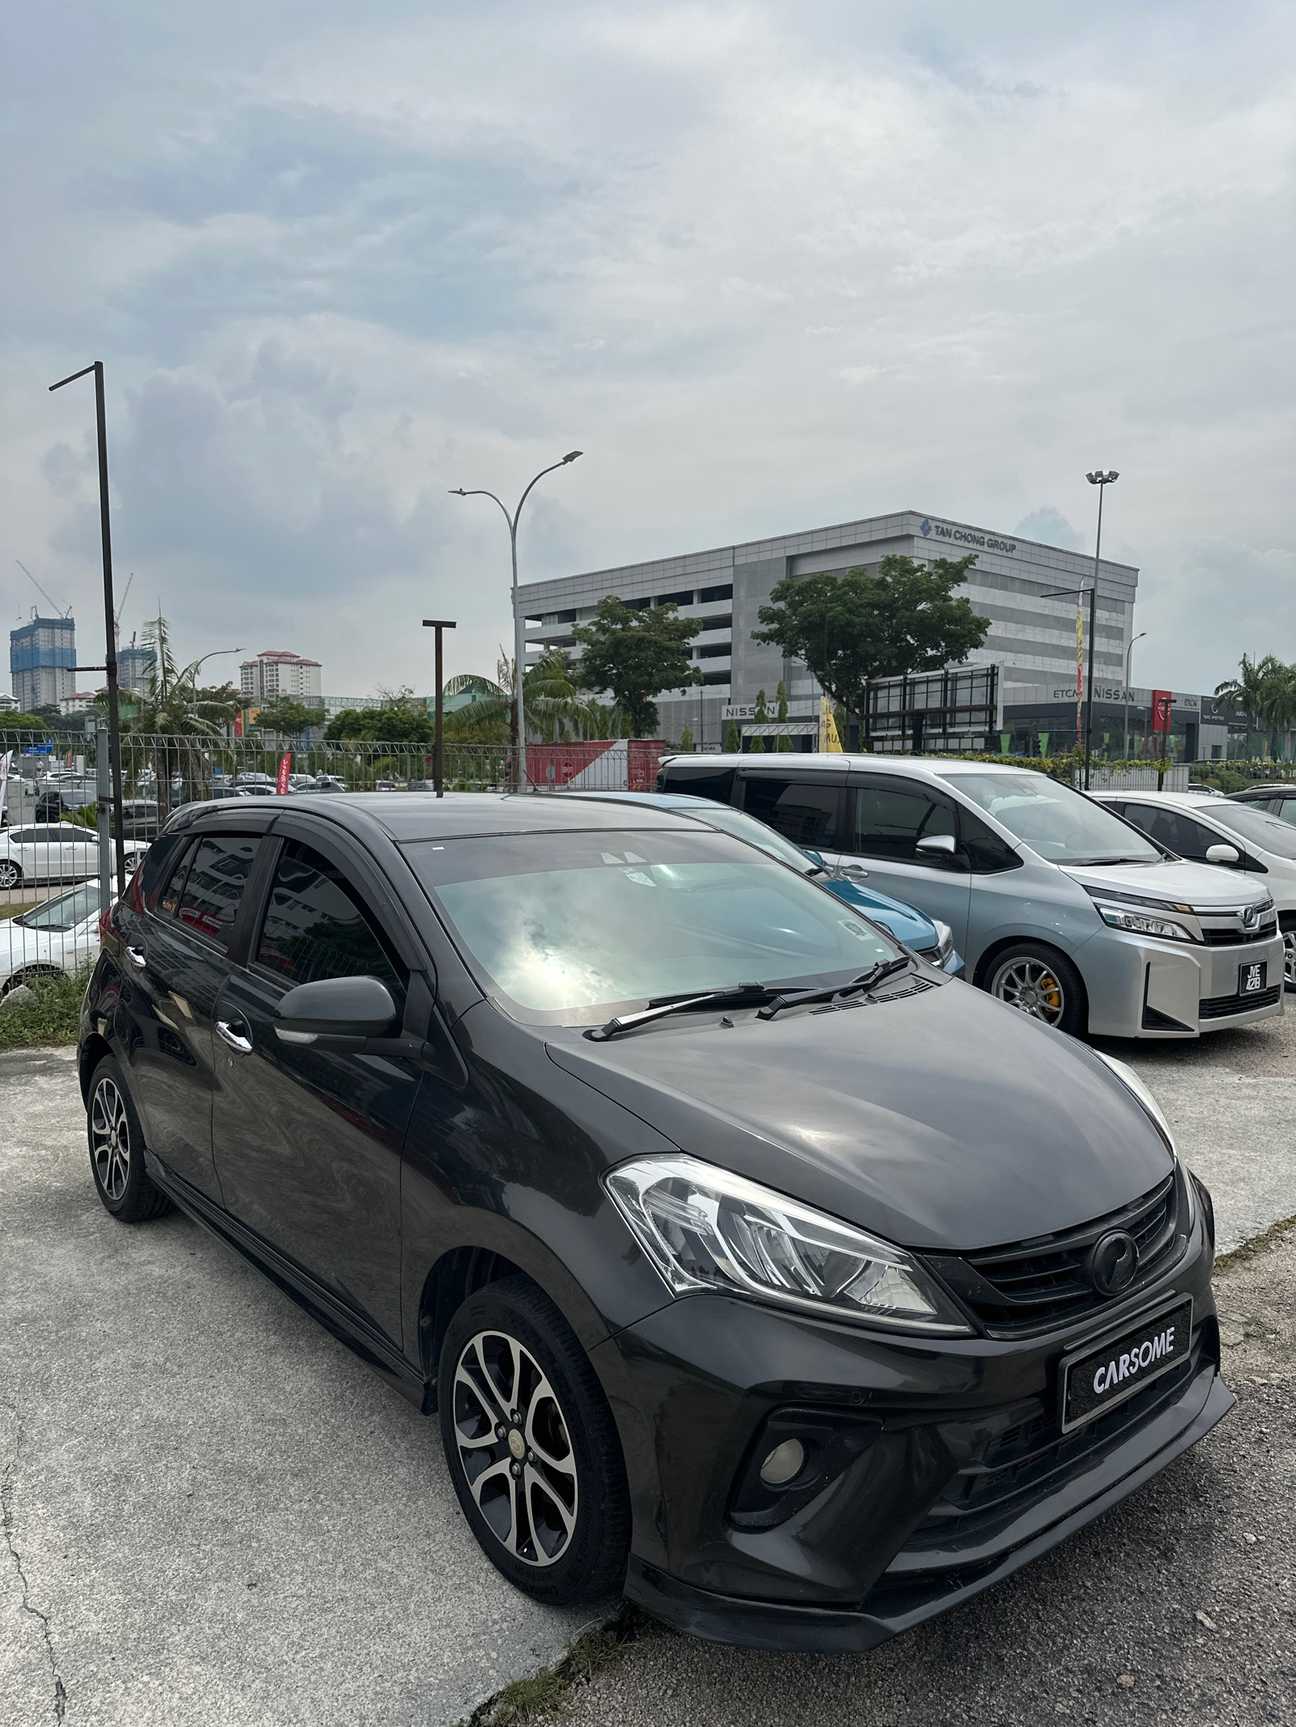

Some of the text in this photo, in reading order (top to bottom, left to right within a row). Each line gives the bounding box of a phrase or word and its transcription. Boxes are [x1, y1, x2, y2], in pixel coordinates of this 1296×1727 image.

[934, 525, 1017, 554] TAN CHONG GROUP
[1094, 687, 1135, 702] NISSAN
[726, 706, 775, 717] NISSN
[1093, 1326, 1175, 1394] CARSOME
